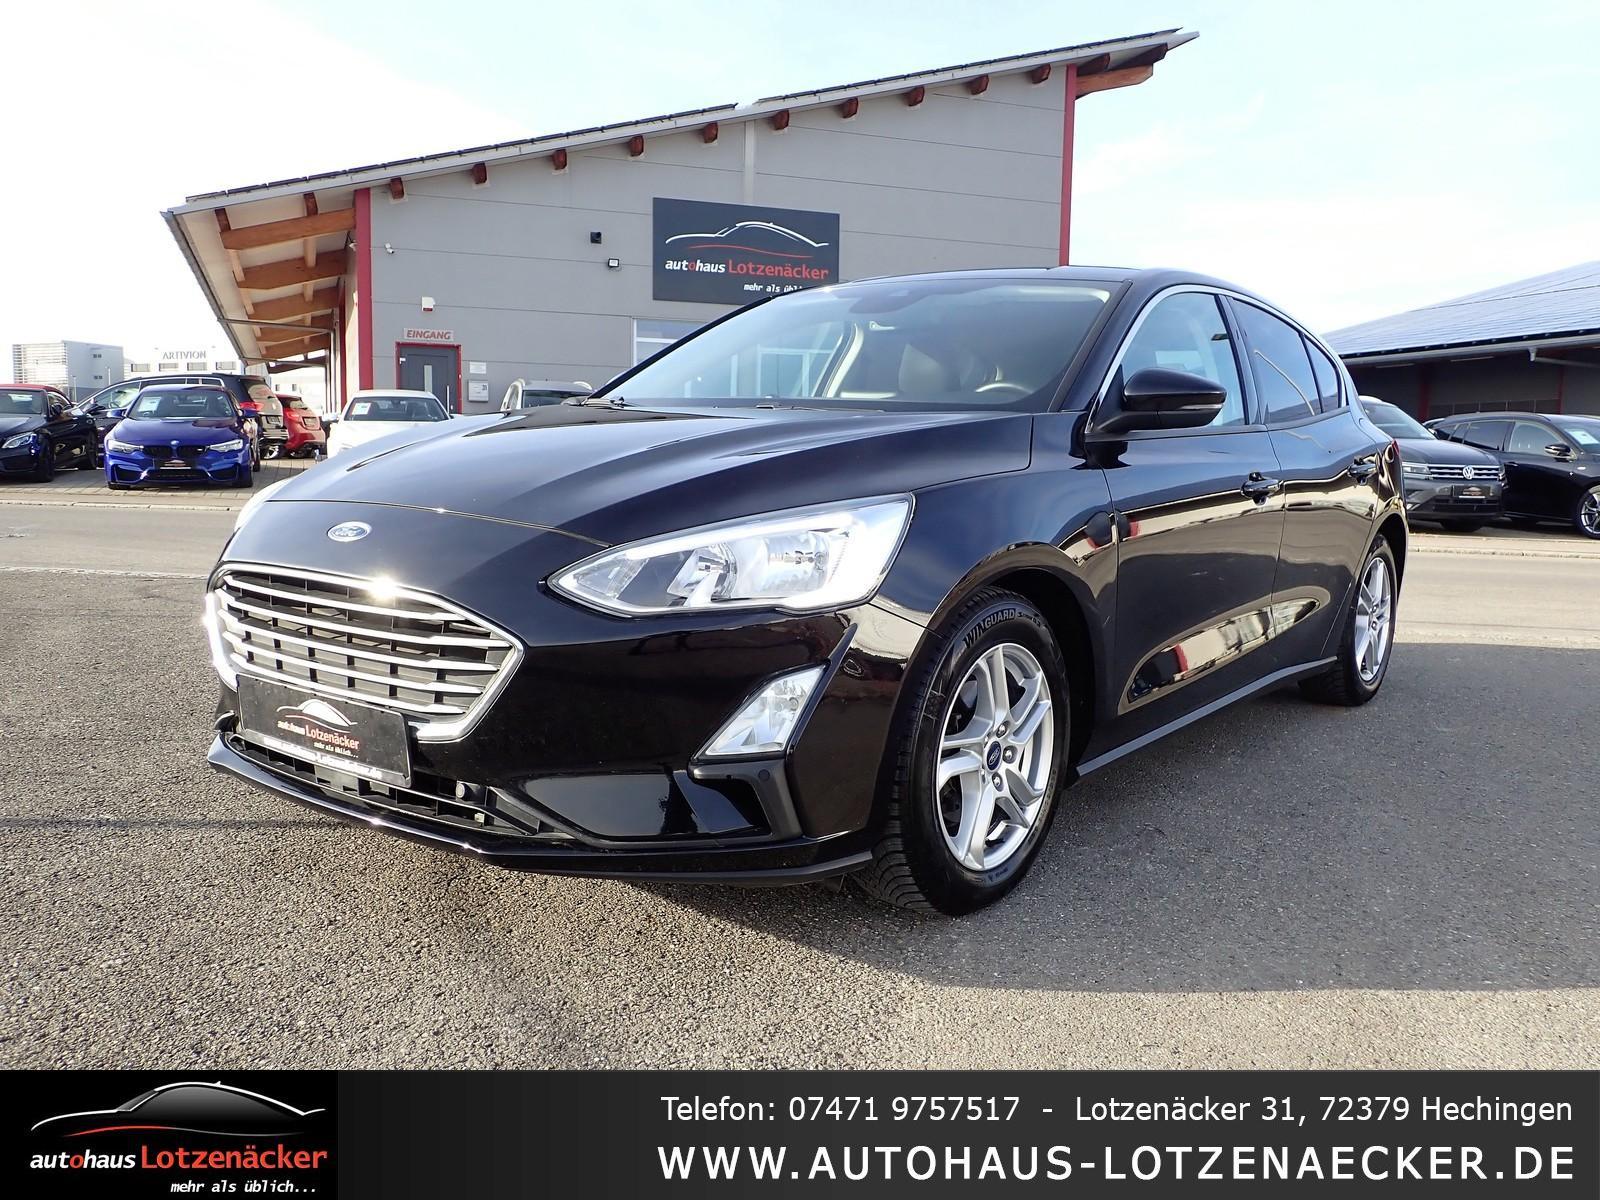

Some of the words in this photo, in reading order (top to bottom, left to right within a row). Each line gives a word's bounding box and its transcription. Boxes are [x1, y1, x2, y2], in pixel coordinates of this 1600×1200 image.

[665, 259, 726, 273] autohaus
[728, 259, 829, 280] Lotzenäcker
[743, 283, 763, 291] mehr
[766, 284, 780, 293] als
[406, 329, 451, 340] EINGANG
[162, 351, 206, 360] ARTIVION
[963, 608, 1016, 648] WINGUARD
